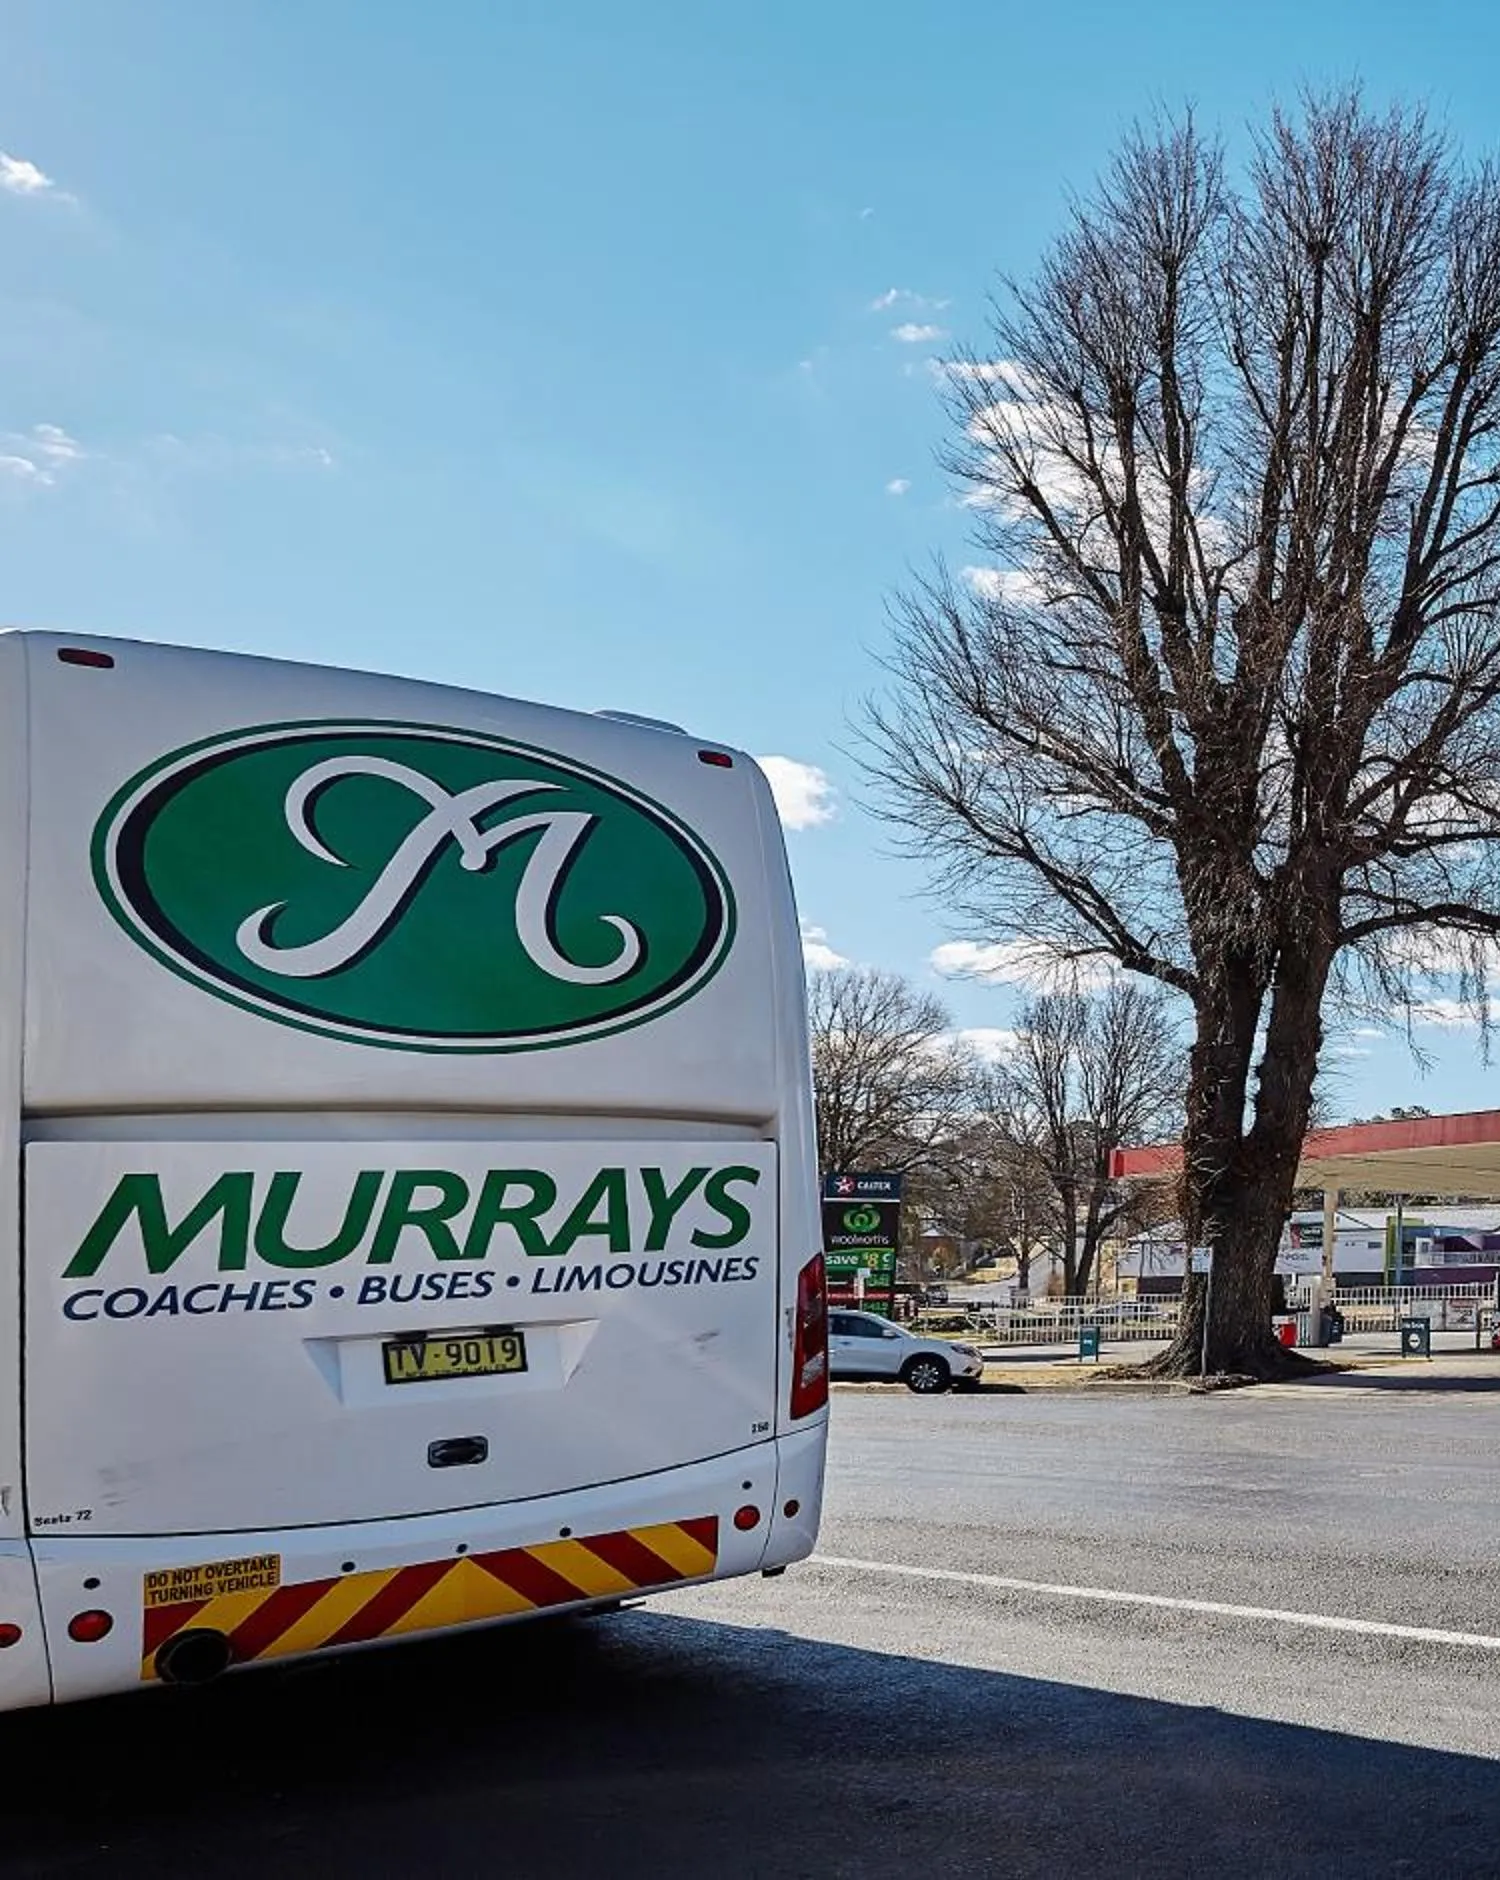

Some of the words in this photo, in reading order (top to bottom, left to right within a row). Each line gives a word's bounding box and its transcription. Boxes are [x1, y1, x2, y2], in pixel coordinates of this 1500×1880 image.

[61, 1166, 761, 1278] MURRAYS
[825, 1255, 859, 1265] save
[63, 1279, 316, 1320] COACHES
[357, 1271, 495, 1305] BUSES
[530, 1257, 760, 1293] LIMOUSINES
[75, 1509, 93, 1520] 72
[150, 1573, 169, 1588] DO
[172, 1567, 201, 1585] NOT
[205, 1555, 277, 1579] OVERTAKE
[150, 1583, 213, 1604] TURNING
[218, 1571, 275, 1593] VEHICLE
